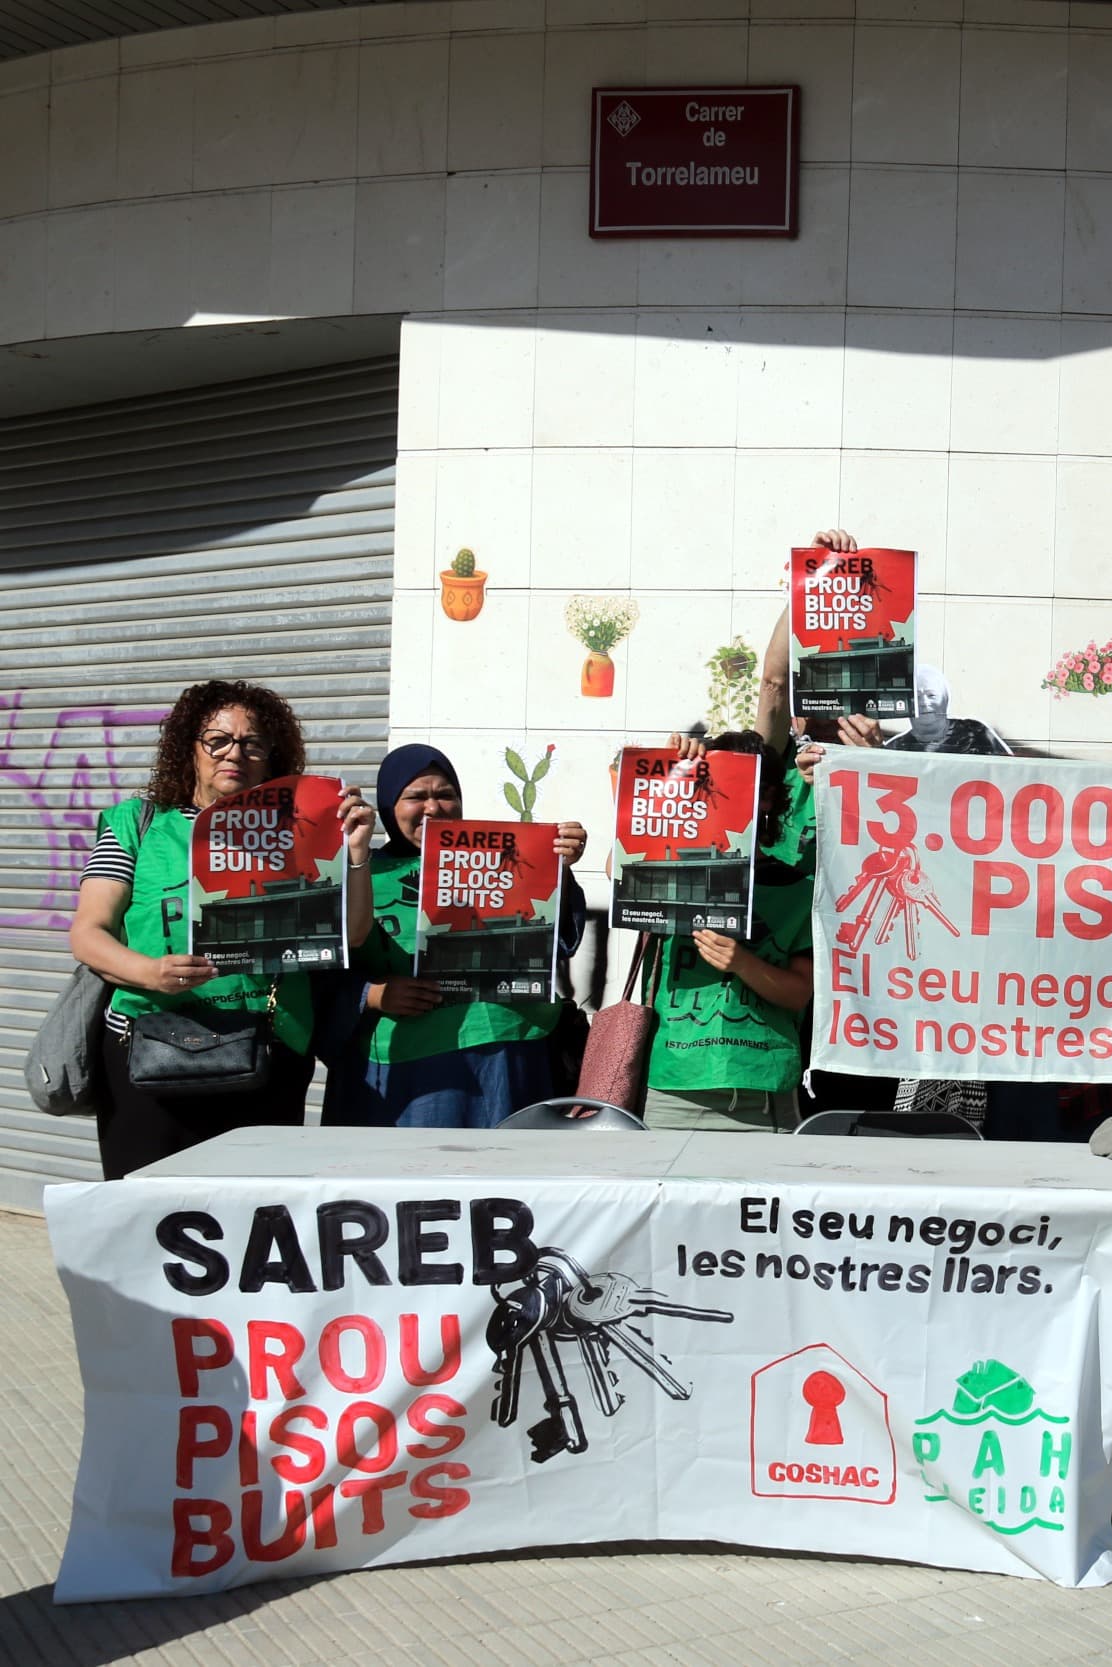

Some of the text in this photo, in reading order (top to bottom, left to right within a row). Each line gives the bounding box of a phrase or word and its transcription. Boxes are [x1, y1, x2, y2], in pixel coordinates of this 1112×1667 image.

[686, 102, 744, 122] Carrer
[703, 128, 726, 146] de
[626, 162, 759, 186] Torrelameu
[805, 558, 872, 574] SREB
[805, 595, 872, 612] BLOCS
[806, 613, 866, 630] BUITS
[635, 759, 710, 777] SAB
[634, 778, 695, 799] PROU
[210, 809, 278, 829] PROU
[632, 799, 707, 819] BLOCS
[631, 818, 698, 839] BUITS
[210, 830, 294, 850] BLOCS
[440, 830, 516, 849] SAREB
[210, 852, 285, 871] BUITS
[439, 850, 500, 869] PROU
[438, 870, 513, 889] BLOCS
[437, 889, 504, 908] BUITS
[832, 949, 870, 997] El
[887, 966, 979, 1003] seu
[829, 1000, 898, 1050] les
[740, 1197, 1062, 1254] El seu negoci,
[156, 1198, 539, 1296] SAREB
[677, 1245, 1053, 1293] les nostres llars.
[172, 1314, 461, 1400] PROU
[176, 1394, 467, 1489] PISOS
[171, 1463, 470, 1577] BUITS
